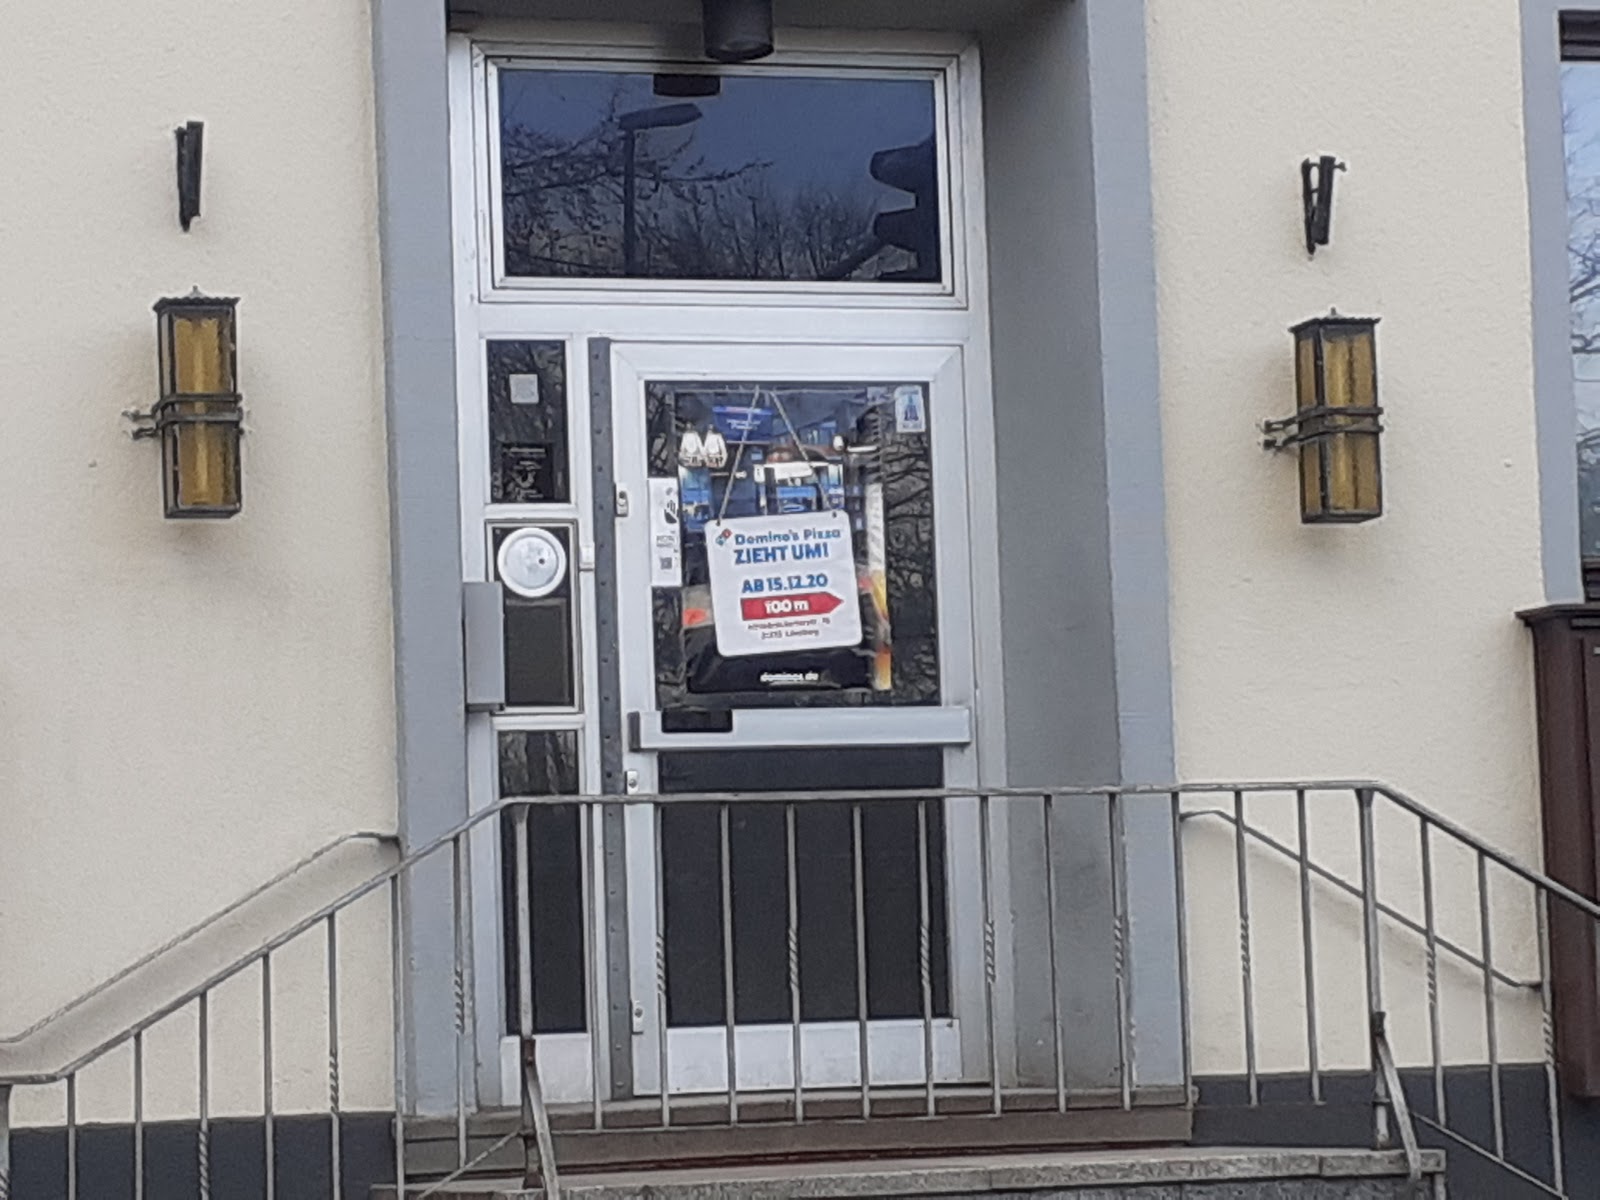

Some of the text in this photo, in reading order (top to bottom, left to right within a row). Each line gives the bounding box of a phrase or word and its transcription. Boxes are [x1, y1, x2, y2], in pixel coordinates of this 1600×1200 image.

[734, 528, 841, 545] Domino's Pizza
[734, 542, 829, 564] ZIEHT UM!
[742, 573, 828, 593] AB 15.12.20
[764, 599, 809, 614] 100 m
